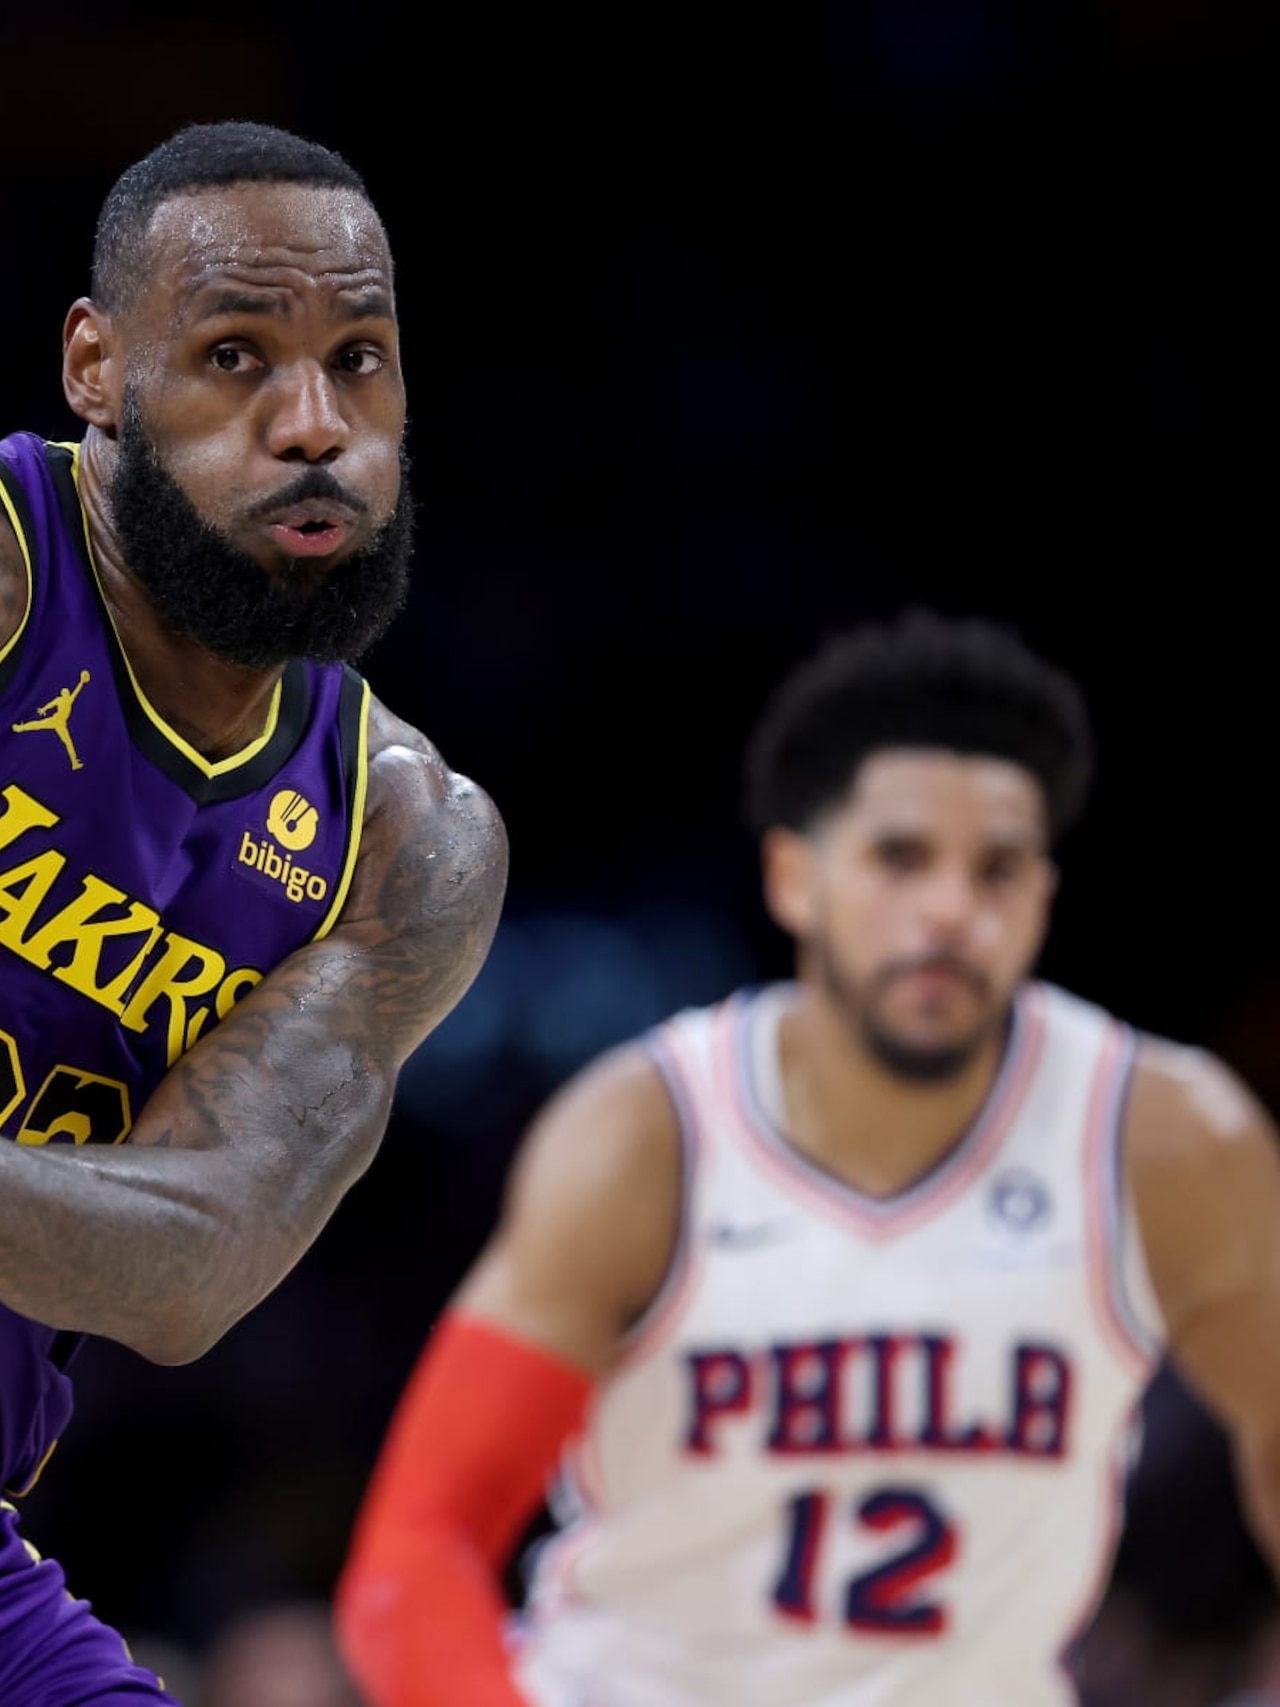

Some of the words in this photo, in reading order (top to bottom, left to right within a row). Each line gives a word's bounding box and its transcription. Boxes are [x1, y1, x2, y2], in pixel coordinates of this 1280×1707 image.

[237, 830, 328, 903] bibigo
[678, 1332, 1076, 1464] PHILA
[770, 1485, 960, 1638] 12
